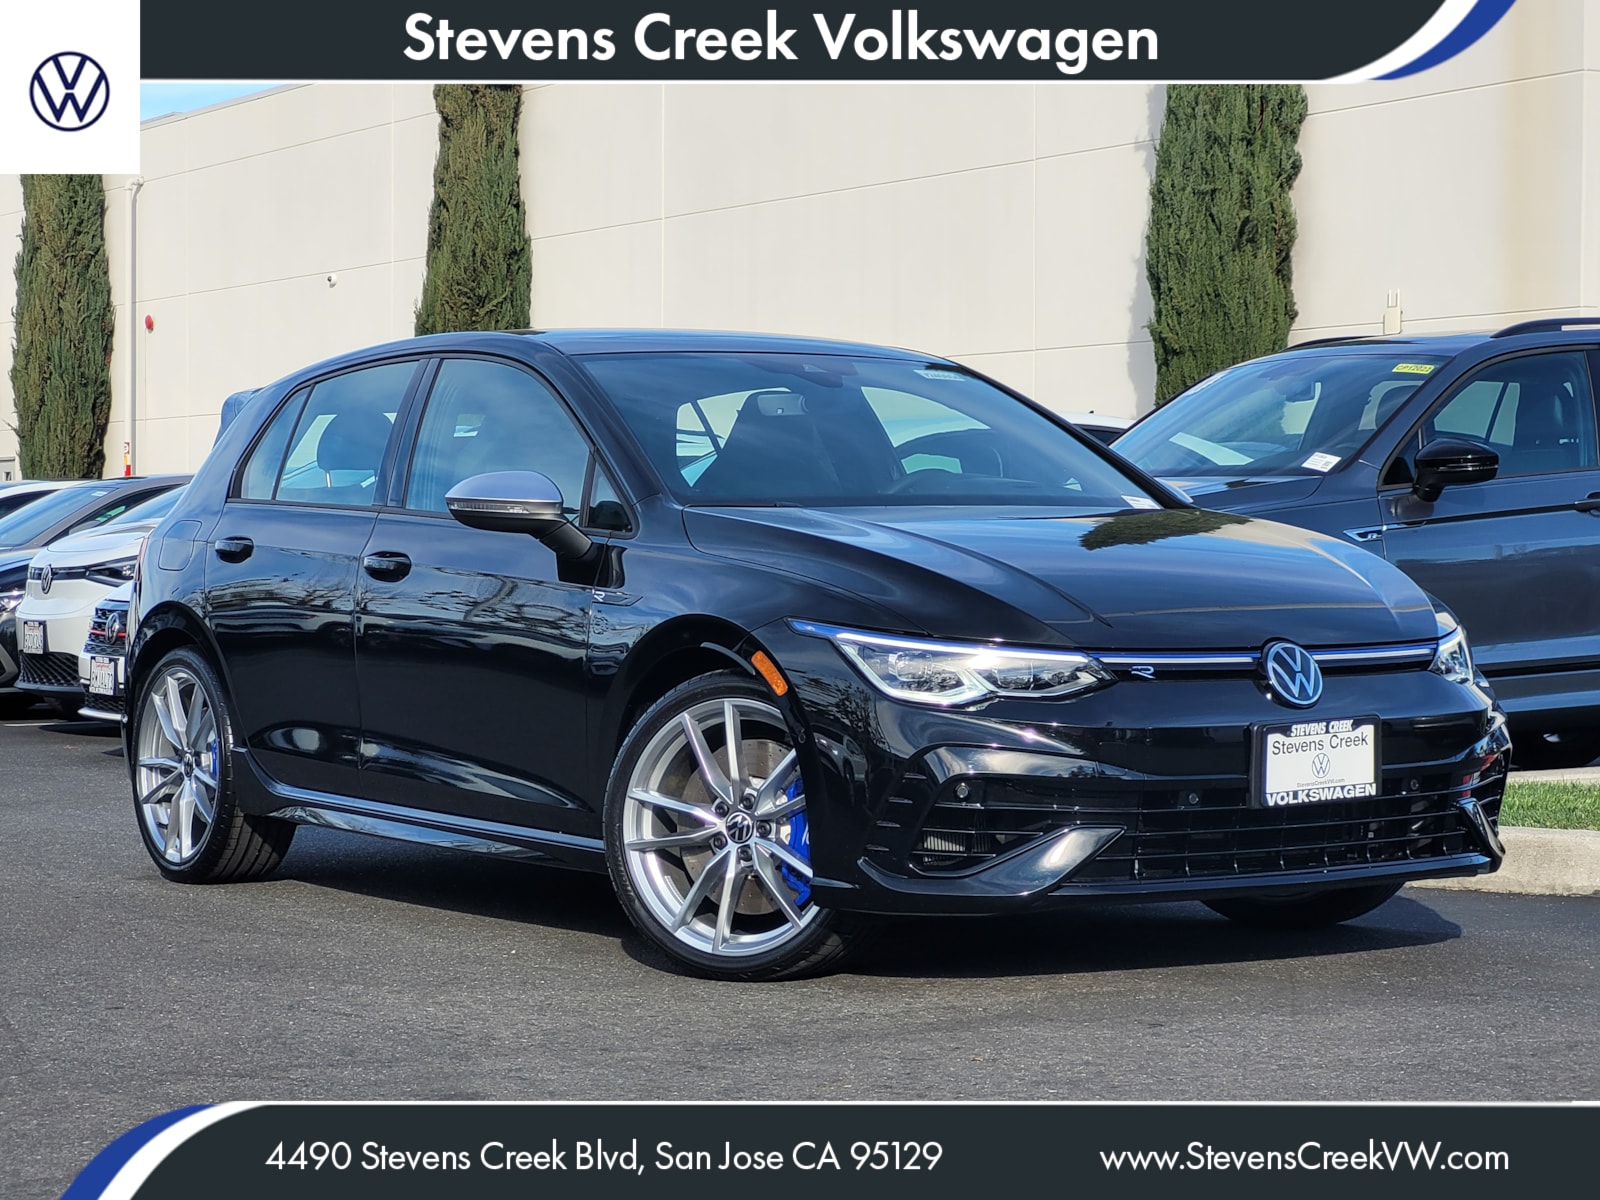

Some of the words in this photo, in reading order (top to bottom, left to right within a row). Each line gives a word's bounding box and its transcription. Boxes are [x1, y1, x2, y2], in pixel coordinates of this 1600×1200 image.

[1131, 665, 1156, 679] R
[1266, 641, 1323, 705] VW
[1290, 721, 1327, 737] STEVENS
[1328, 719, 1354, 733] CREEK
[1271, 739, 1325, 756] Stevens
[1329, 731, 1369, 749] Creek
[1311, 752, 1331, 778] VW
[1265, 782, 1377, 807] VOLKSWAGEN
